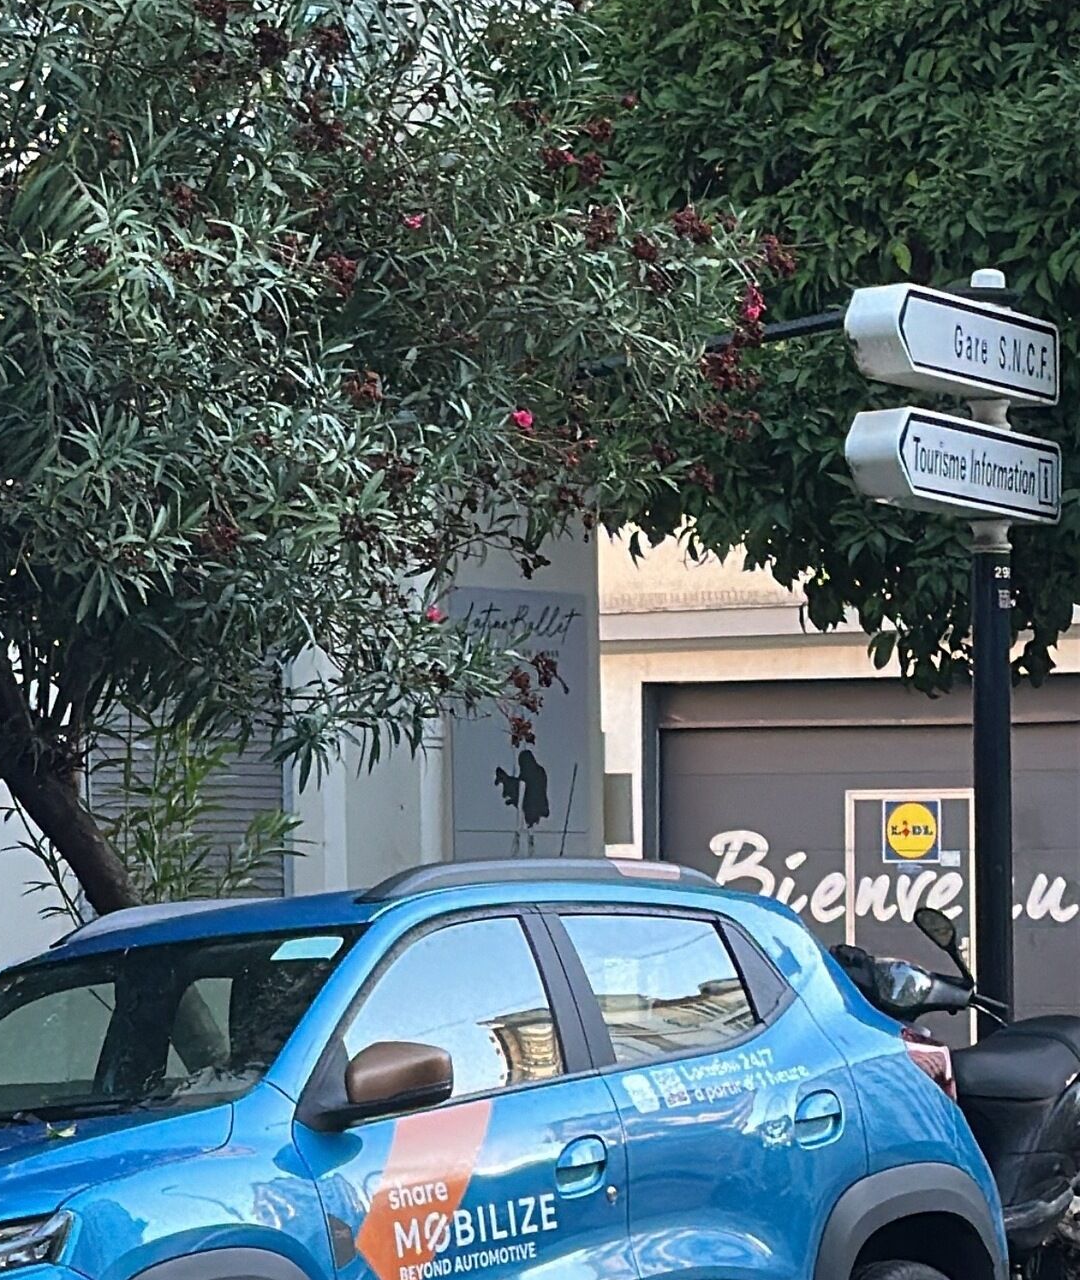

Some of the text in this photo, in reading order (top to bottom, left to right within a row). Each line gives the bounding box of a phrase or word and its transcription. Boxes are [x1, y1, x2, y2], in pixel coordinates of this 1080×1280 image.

[954, 324, 988, 365] Gare
[913, 436, 967, 481] Tourisme
[970, 449, 1036, 497] Information
[891, 820, 934, 837] LIDL
[709, 829, 1079, 923] Bienveu
[388, 1181, 448, 1210] share
[454, 1242, 537, 1273] AUTOMOTIVE
